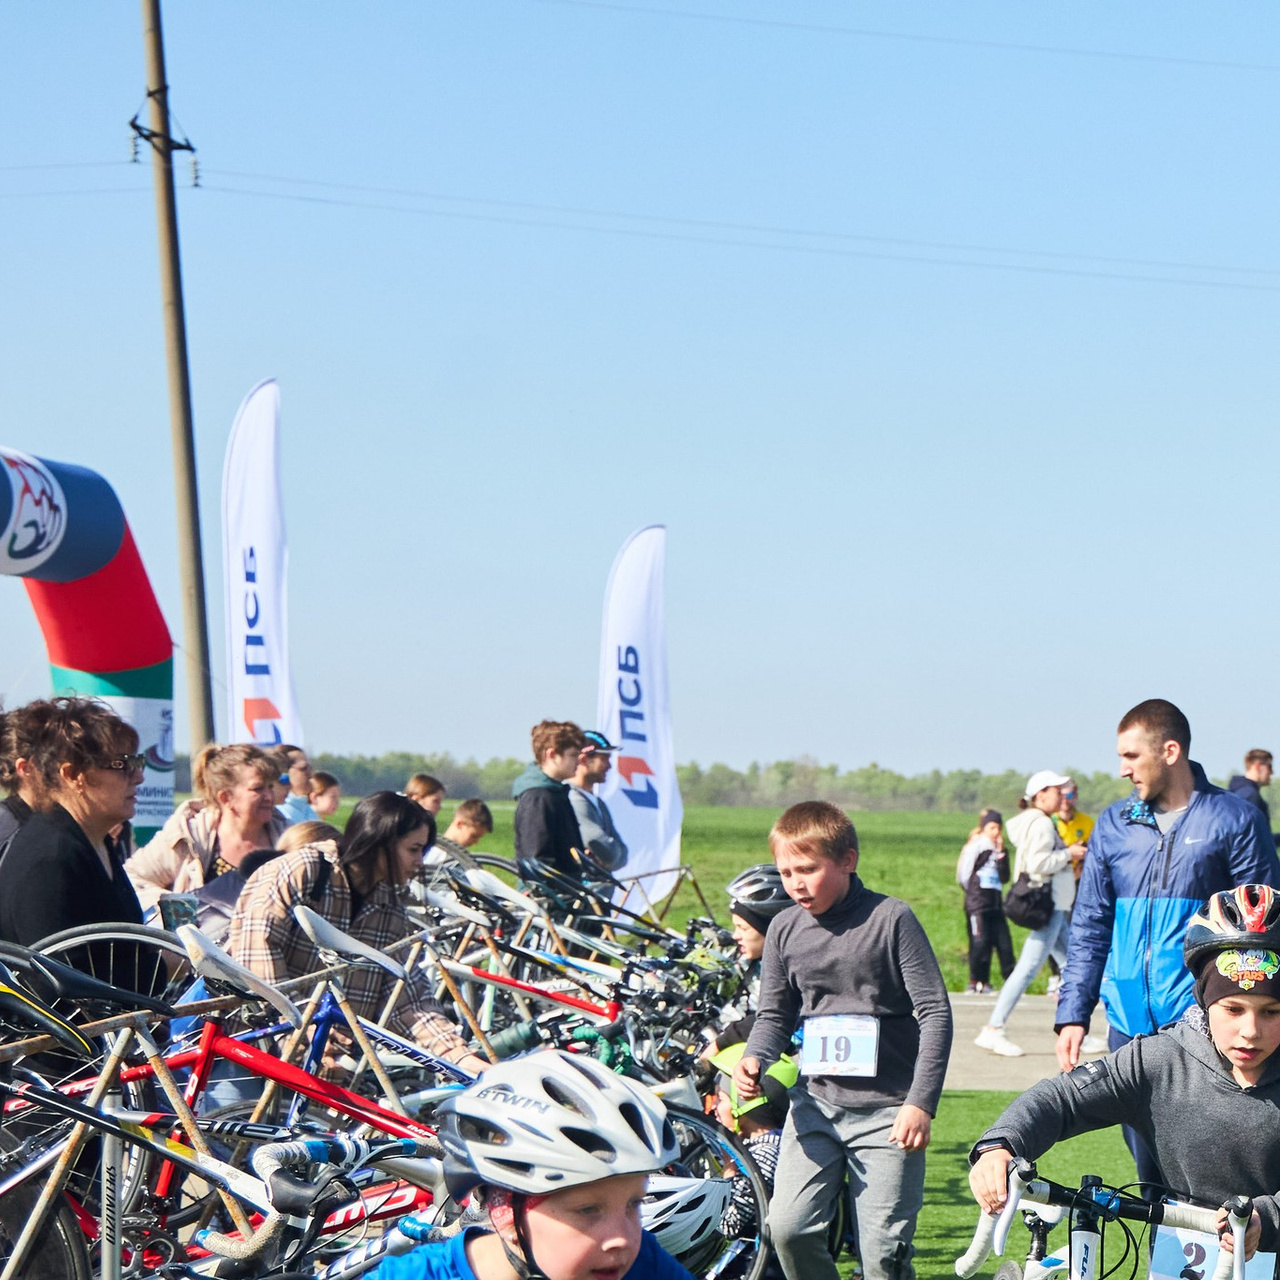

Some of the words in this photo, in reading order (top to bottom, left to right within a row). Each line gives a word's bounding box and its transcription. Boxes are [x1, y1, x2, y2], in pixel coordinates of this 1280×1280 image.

[243, 546, 270, 675] ПСБ
[618, 645, 647, 742] ПСБ
[1230, 970, 1266, 982] STARS
[819, 1036, 851, 1063] 19
[105, 1165, 117, 1246] SPECIALIZED
